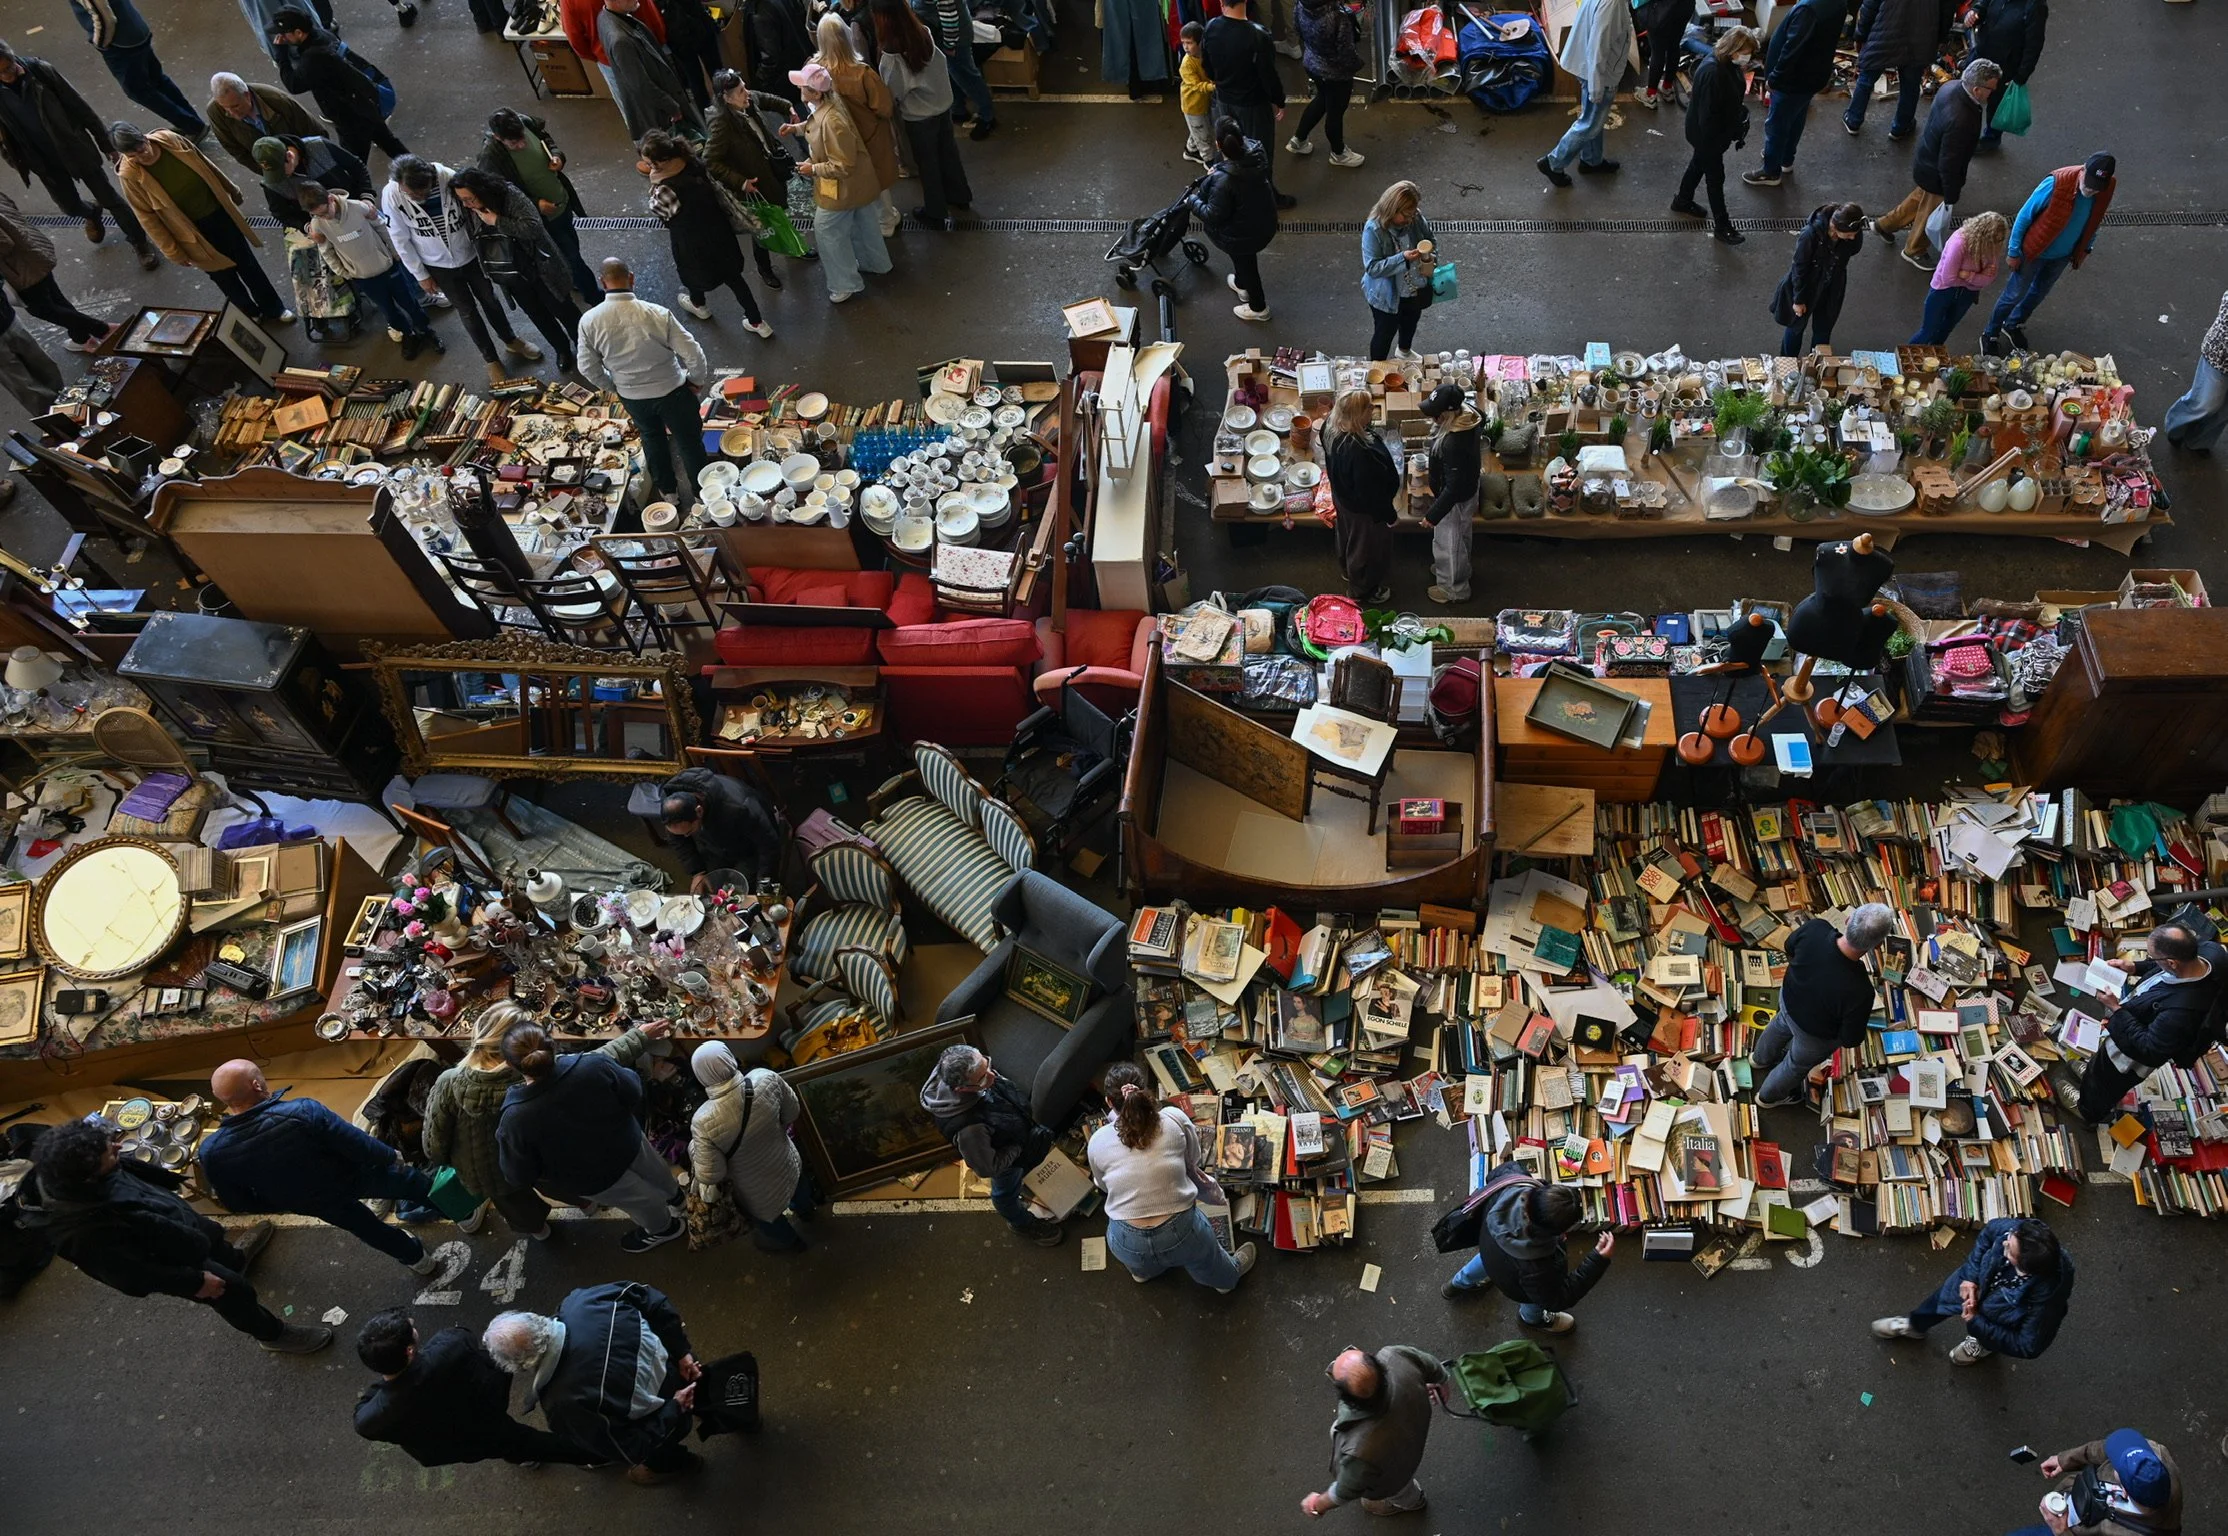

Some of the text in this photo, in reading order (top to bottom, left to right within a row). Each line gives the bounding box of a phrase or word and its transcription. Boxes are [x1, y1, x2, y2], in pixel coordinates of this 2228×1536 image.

[336, 231, 360, 243] PUMA
[1367, 1015, 1408, 1029] EGON SCHIELE
[1686, 1136, 1716, 1151] Italia
[1037, 1160, 1055, 1178] PIETER
[413, 1239, 528, 1305] 24
